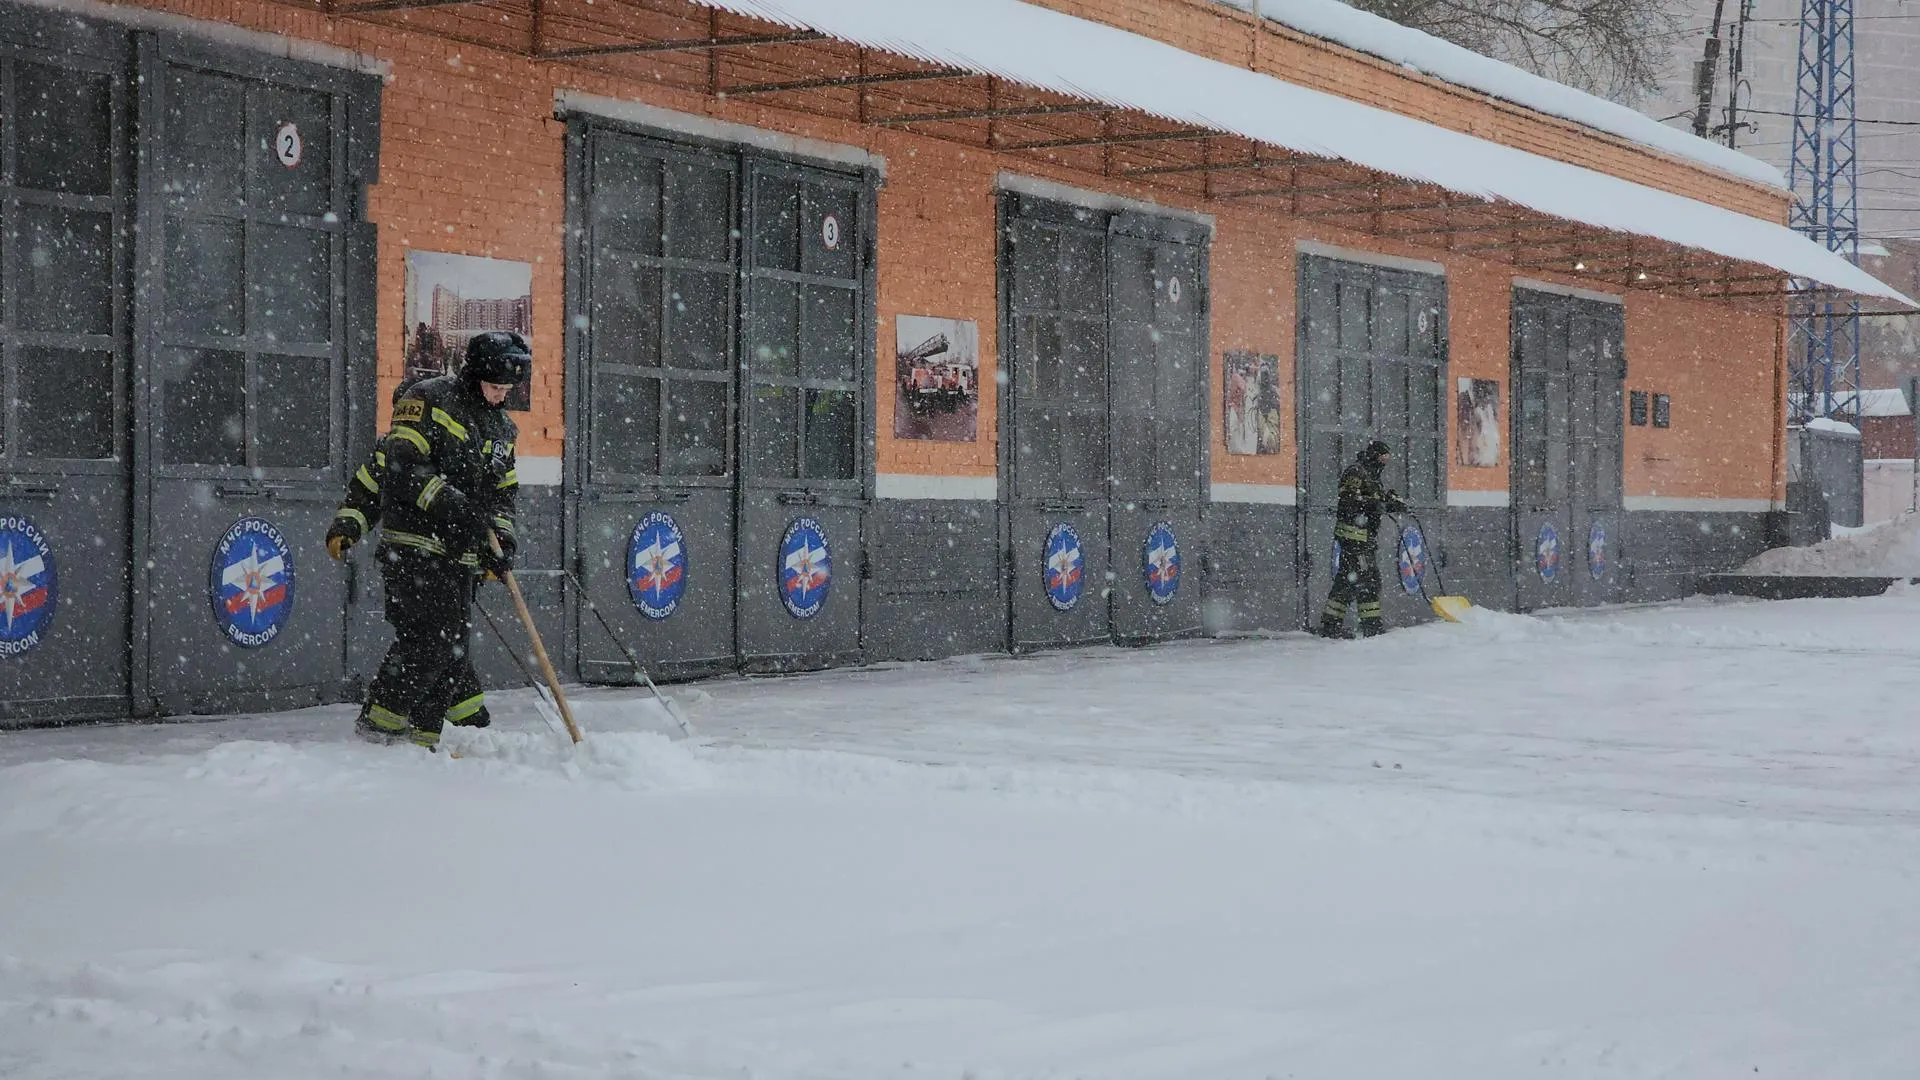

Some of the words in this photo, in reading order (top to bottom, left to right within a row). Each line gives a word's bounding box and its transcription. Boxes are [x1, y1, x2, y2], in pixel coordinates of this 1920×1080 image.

[285, 135, 293, 158] 2
[828, 223, 834, 240] 3
[1172, 282, 1178, 296] 4
[0, 517, 49, 556] РОССИИ
[220, 525, 242, 554] МЧС
[245, 521, 289, 556] РОССИИ
[633, 518, 649, 542] МЧС
[651, 512, 683, 541] РОССИИ
[785, 522, 799, 544] МЧС
[801, 518, 828, 547] РОССИИ
[640, 600, 677, 618] EMERCOM
[787, 599, 819, 617] EMERCOM
[0, 630, 39, 654] ERCOM
[228, 624, 278, 645] EMERCOM
